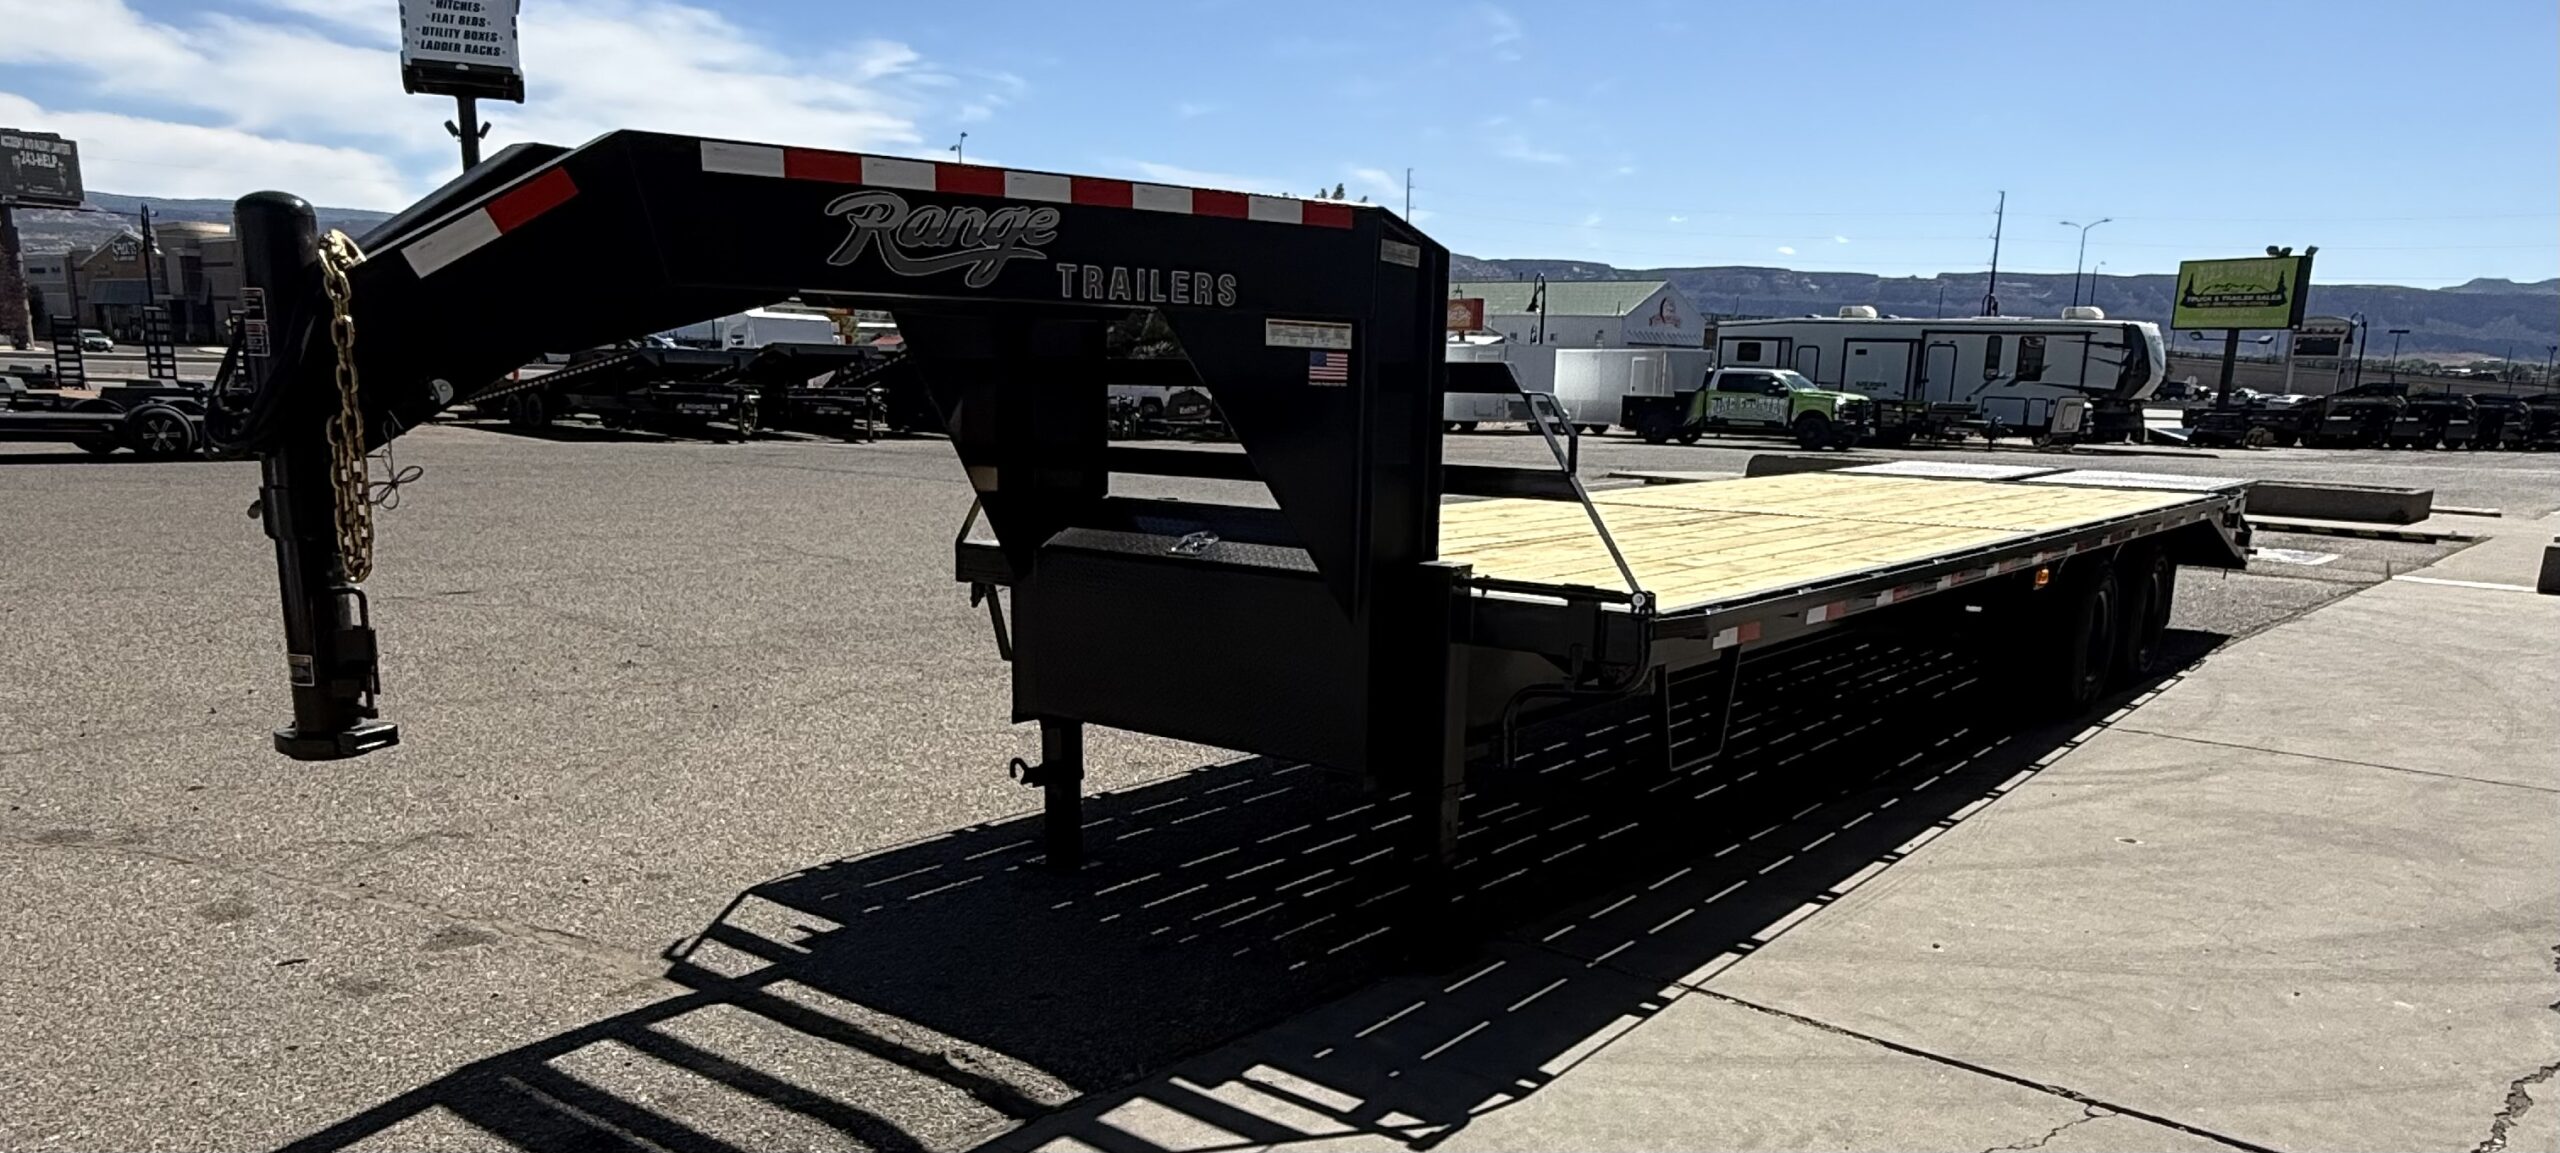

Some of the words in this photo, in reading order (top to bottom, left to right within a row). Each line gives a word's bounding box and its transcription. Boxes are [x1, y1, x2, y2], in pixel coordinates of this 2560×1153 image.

[436, 0, 480, 12] HITCHES
[431, 13, 455, 24] FLAT
[458, 15, 486, 27] BEDS
[422, 26, 460, 39] UTILITY
[463, 30, 498, 42] BOXES
[421, 39, 461, 53] LADDER
[464, 44, 501, 57] RACKS
[824, 190, 1061, 288] Range
[1056, 263, 1238, 306] TRAILERS
